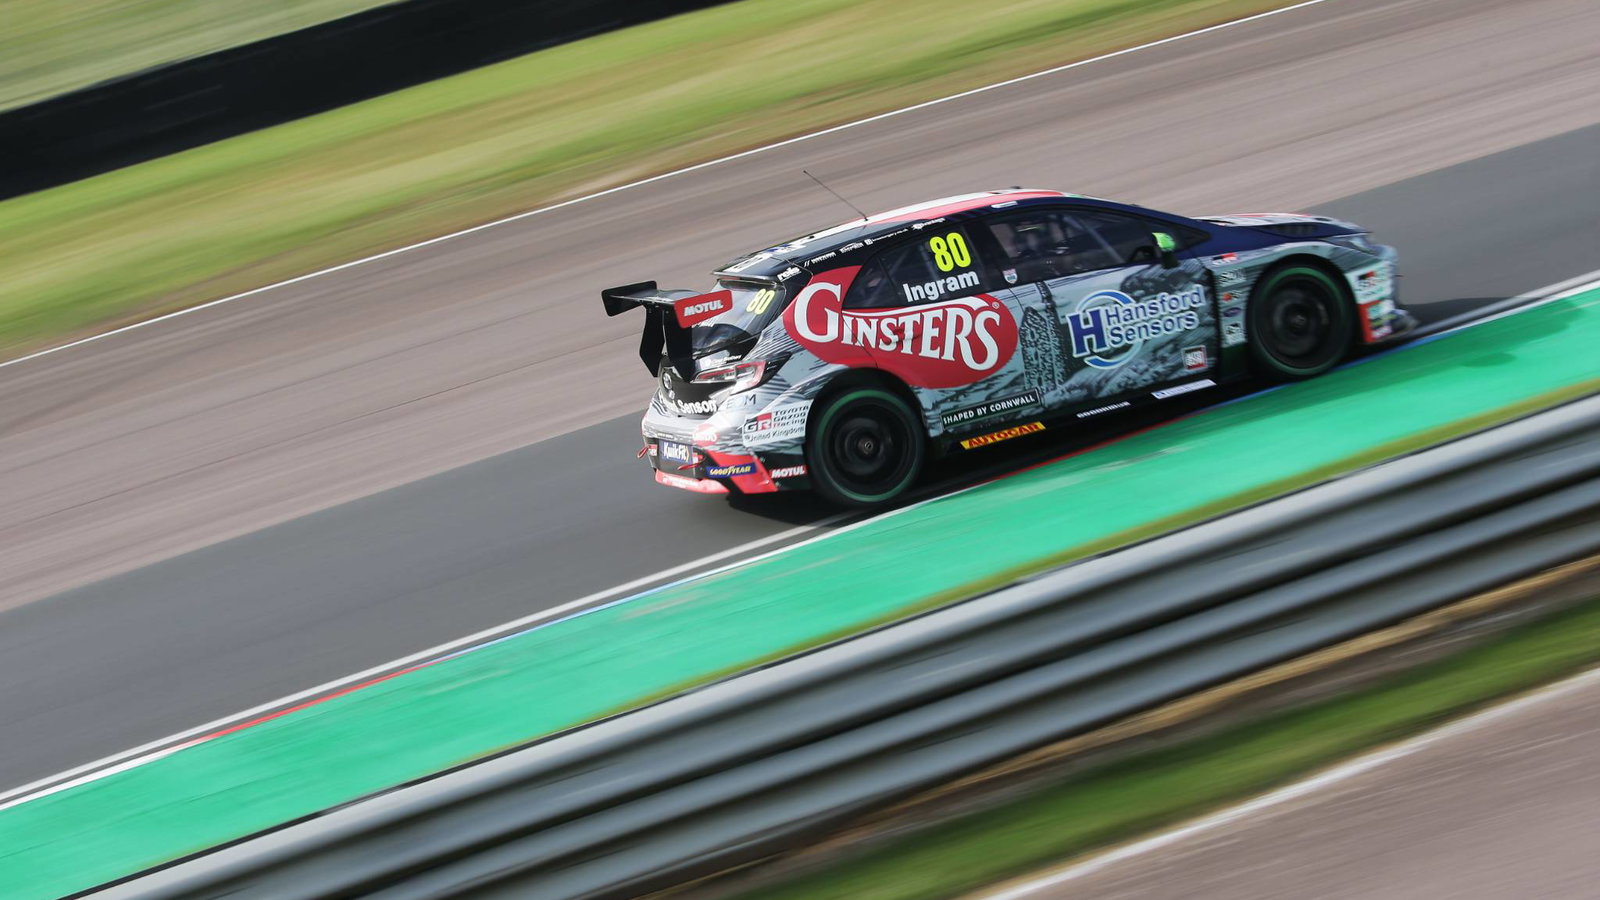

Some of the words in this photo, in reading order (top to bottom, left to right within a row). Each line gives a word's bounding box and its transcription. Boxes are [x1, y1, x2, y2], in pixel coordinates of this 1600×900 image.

[928, 232, 972, 273] 80
[903, 270, 980, 302] Ingram
[683, 300, 724, 317] MOTUL
[746, 288, 776, 315] 80
[1105, 286, 1204, 326] Hansford
[1109, 312, 1197, 346] Sensors
[773, 411, 806, 423] GAZOO
[774, 405, 809, 417] TOYOTA
[943, 410, 974, 425] SHAPED
[977, 407, 987, 417] BY
[990, 395, 1036, 412] CORNWALL
[744, 420, 773, 434] GR
[771, 426, 805, 438] Kingdom
[773, 418, 806, 430] Racing
[967, 423, 1041, 448] AUTOCAR
[709, 465, 752, 477] GOODYEAR
[771, 466, 805, 478] MOTUL
